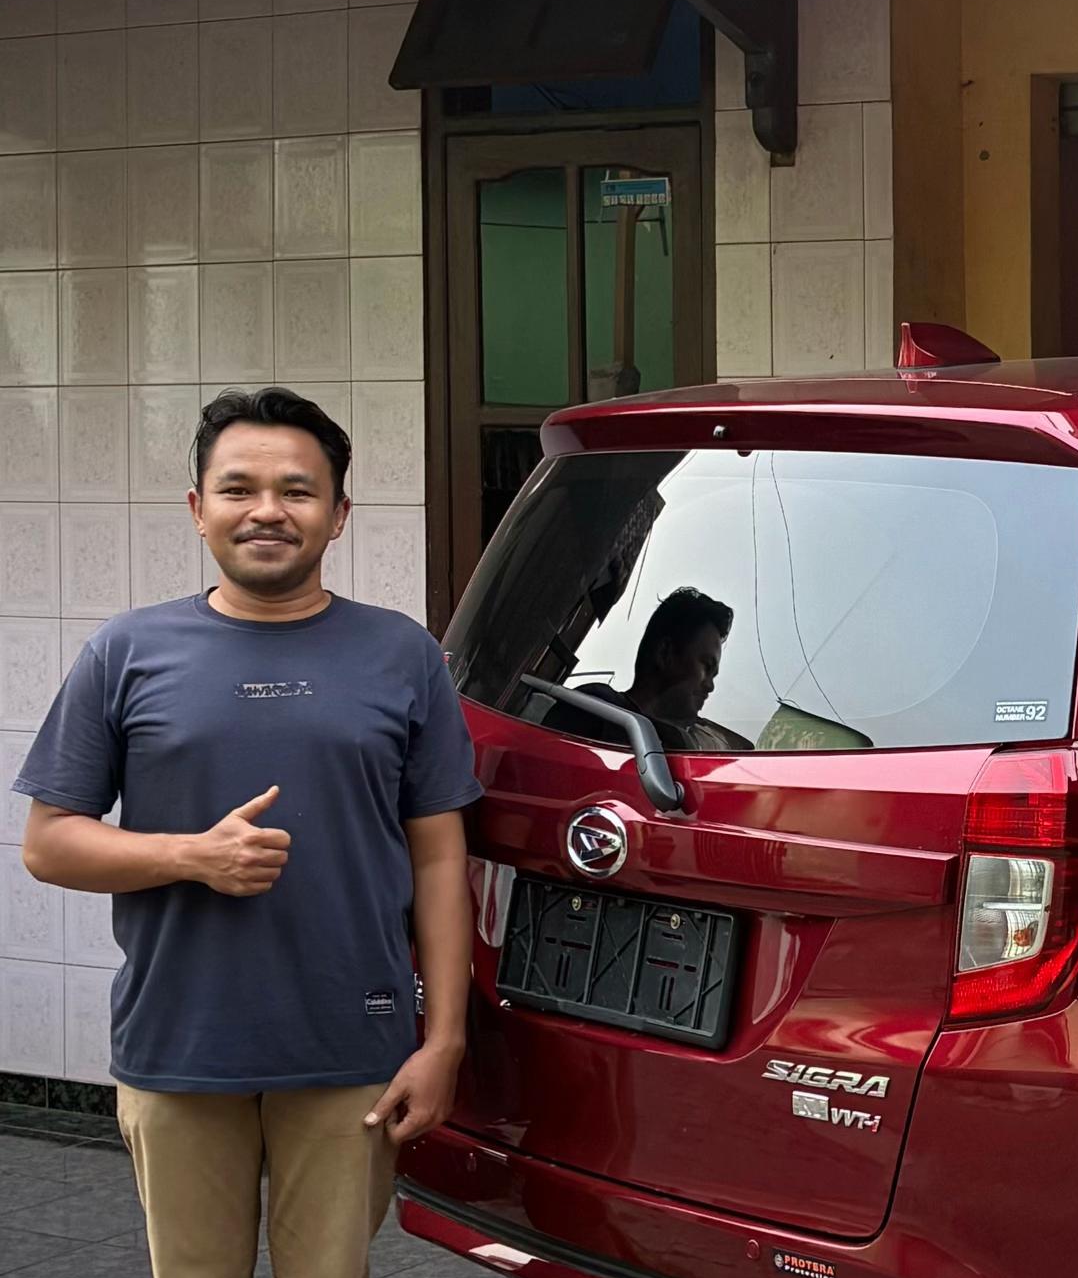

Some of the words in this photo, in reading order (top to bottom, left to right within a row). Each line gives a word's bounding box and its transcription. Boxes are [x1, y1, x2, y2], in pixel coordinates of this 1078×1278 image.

[996, 705, 1025, 714] OCTANE
[1025, 705, 1046, 721] 92
[995, 714, 1026, 722] NUMBER
[761, 1059, 890, 1098] SIGRA
[784, 1254, 835, 1276] PROTERA
